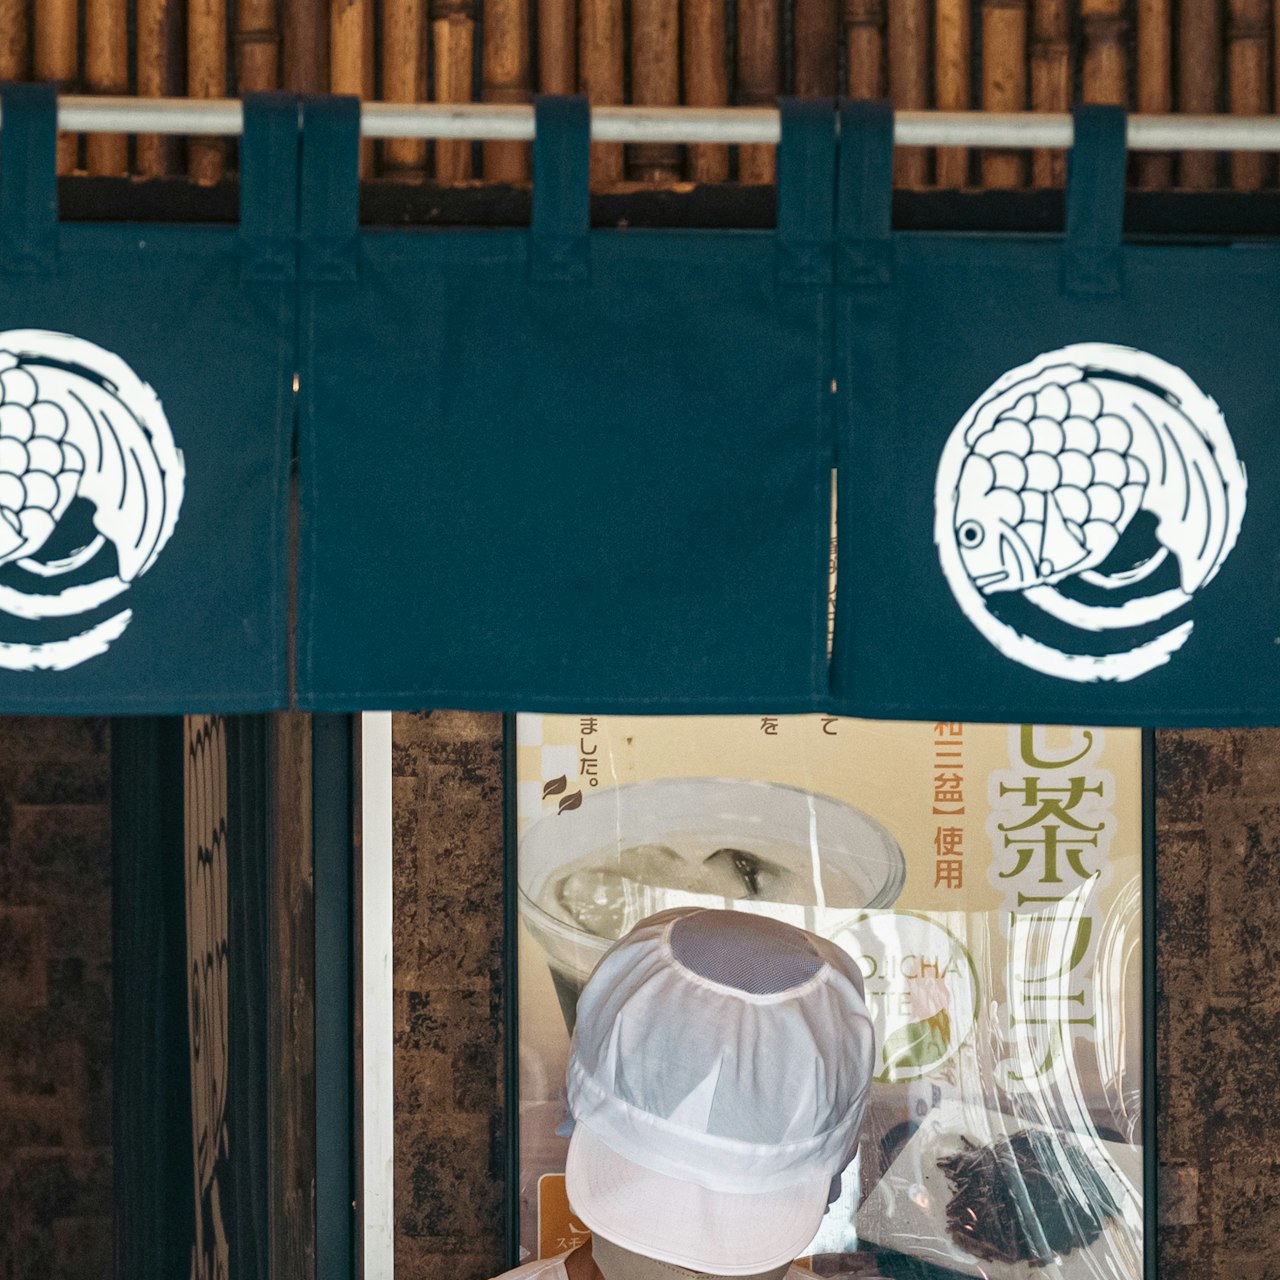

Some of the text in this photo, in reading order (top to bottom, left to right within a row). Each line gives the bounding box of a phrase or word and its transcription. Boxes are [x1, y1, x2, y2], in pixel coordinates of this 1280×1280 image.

[760, 717, 778, 735] を
[820, 717, 838, 735] て
[579, 716, 598, 788] ました。
